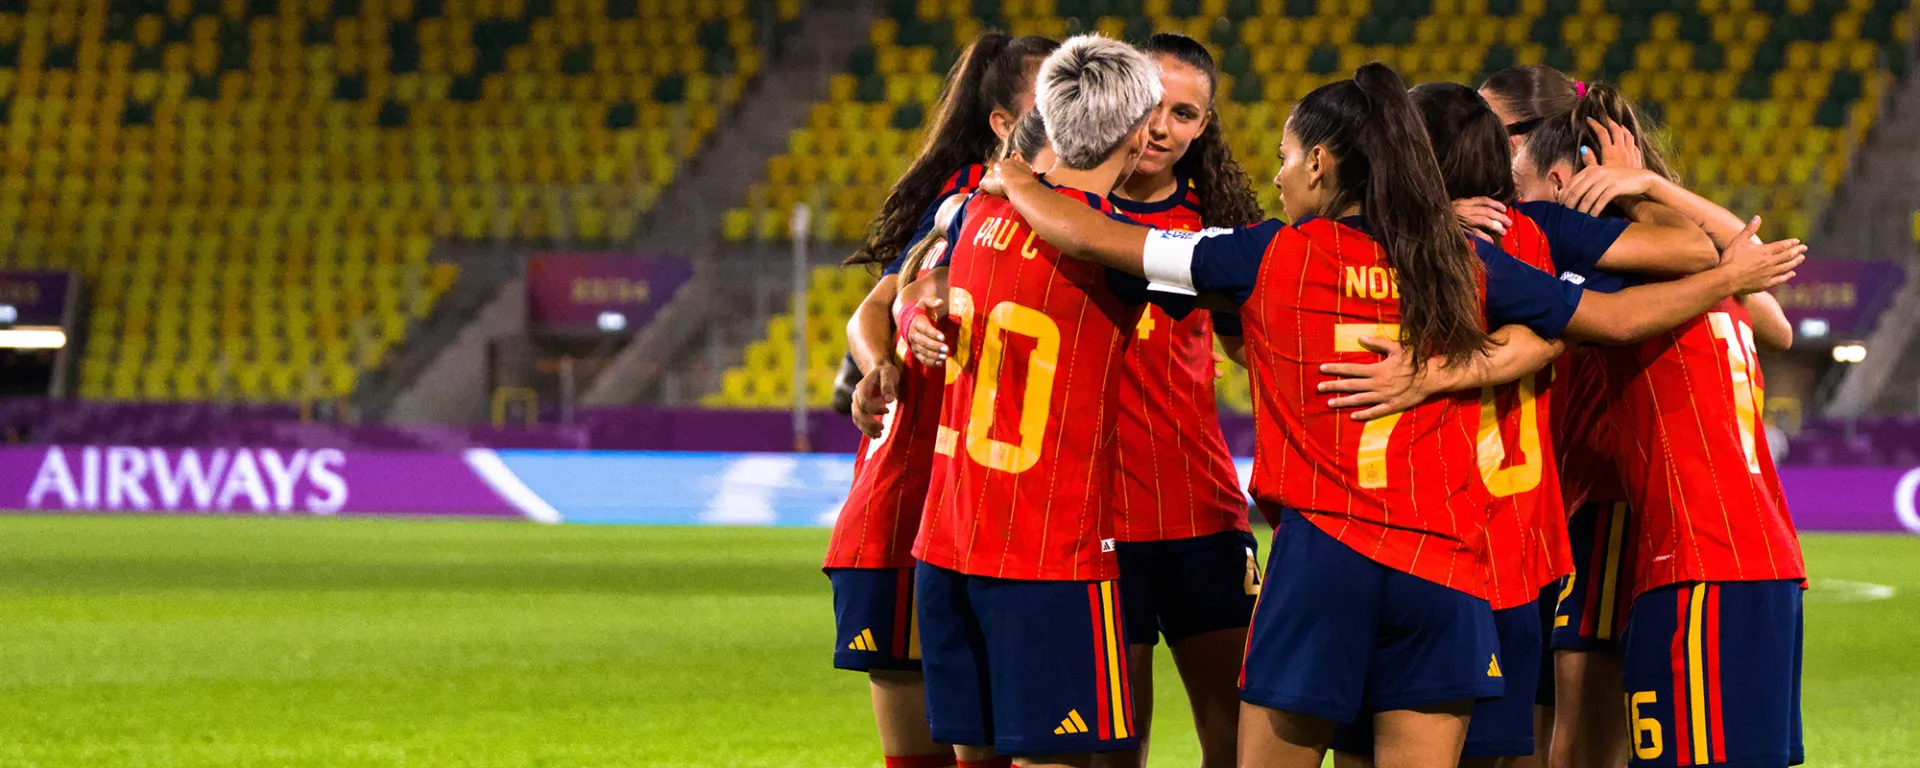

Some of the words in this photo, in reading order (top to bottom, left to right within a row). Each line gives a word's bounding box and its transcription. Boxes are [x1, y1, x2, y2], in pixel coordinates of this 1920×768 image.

[973, 217, 1019, 251] PAU
[934, 286, 1060, 474] 20
[1334, 323, 1412, 489] 7
[26, 445, 349, 514] AIRWAYS
